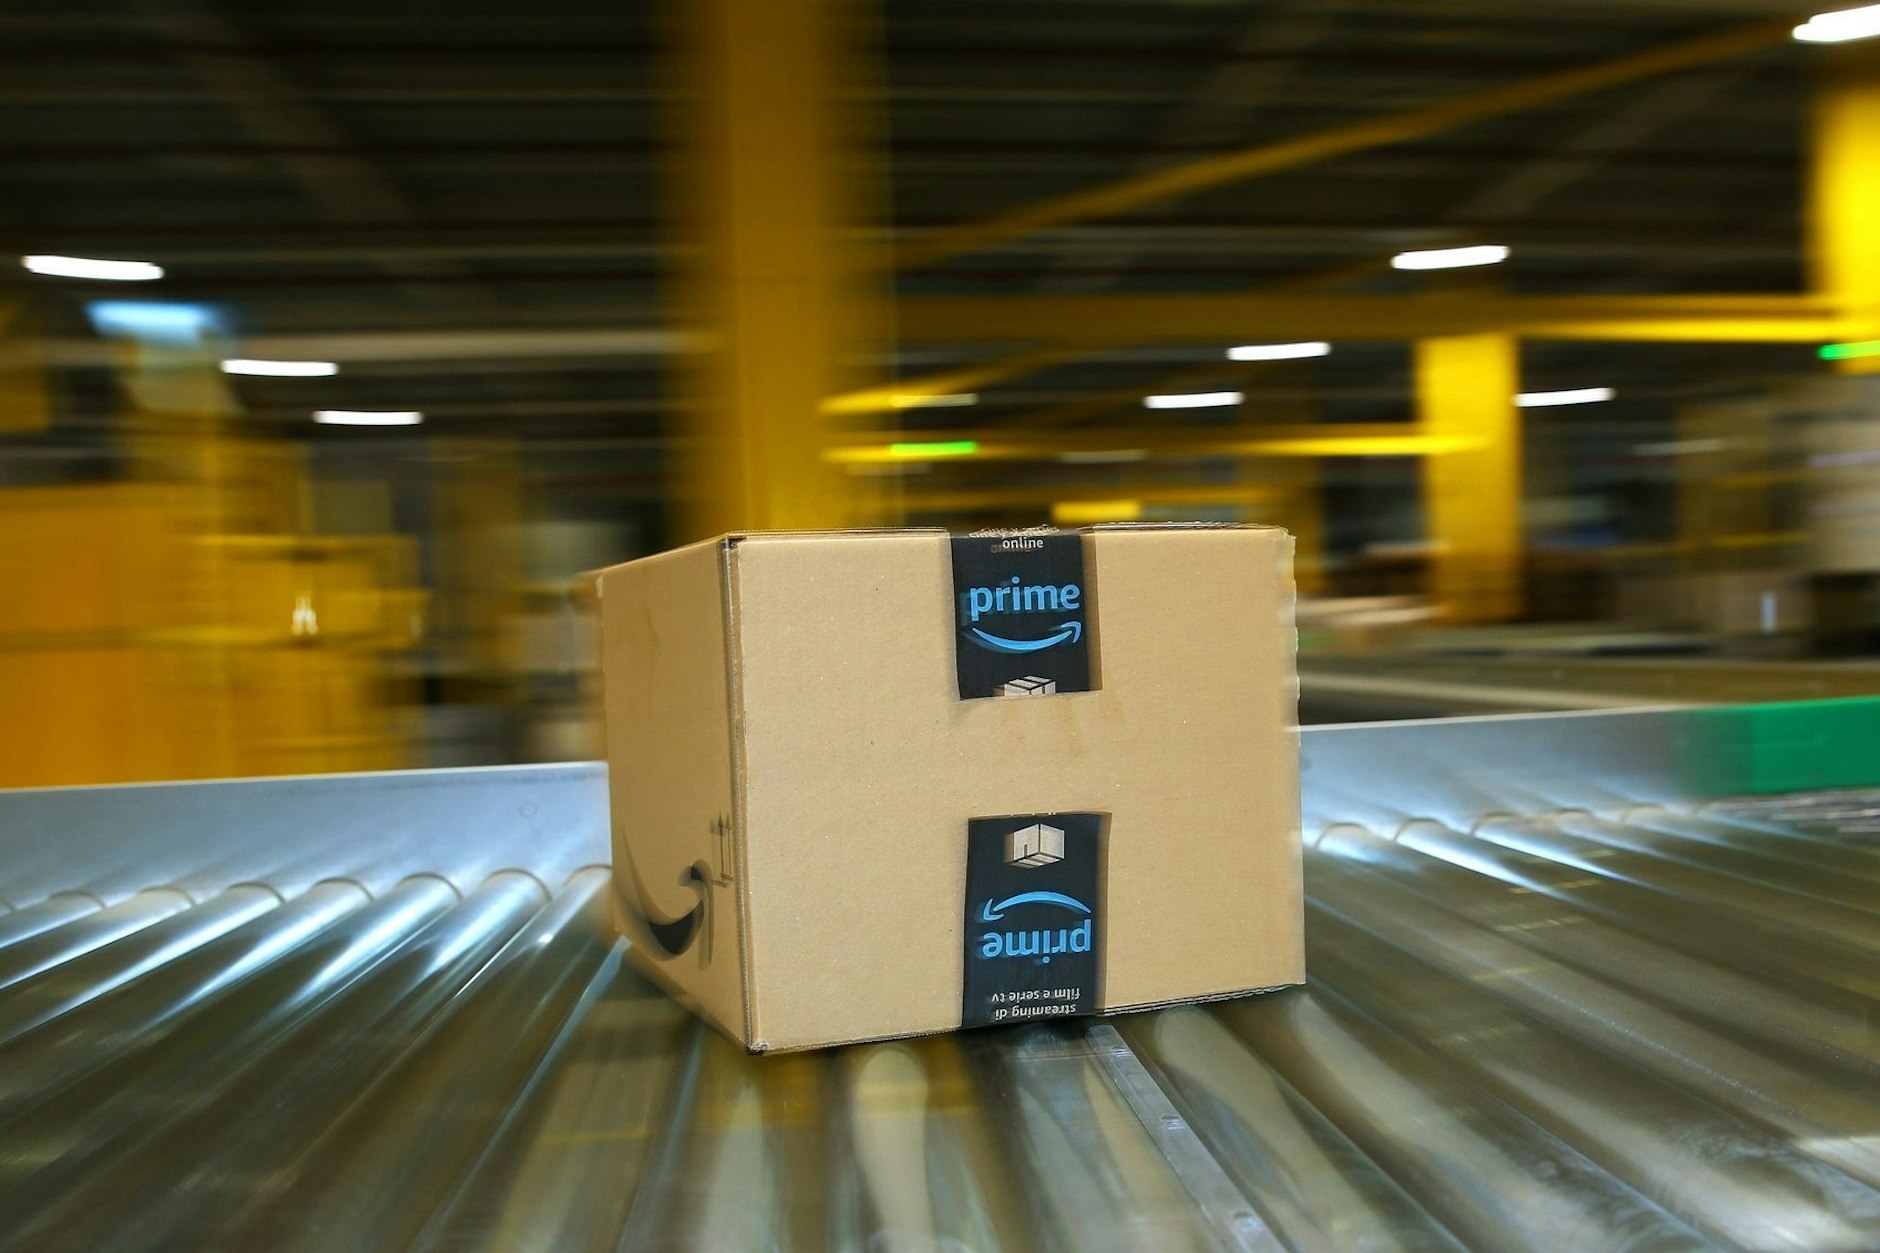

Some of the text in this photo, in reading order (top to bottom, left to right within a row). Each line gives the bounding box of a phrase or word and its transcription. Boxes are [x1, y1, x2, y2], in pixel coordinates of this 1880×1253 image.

[1003, 537, 1044, 549] online
[970, 576, 1080, 621] prime
[982, 919, 1091, 963] prime
[991, 987, 1080, 1003] film e serie tv
[995, 1004, 1077, 1020] streaming di
